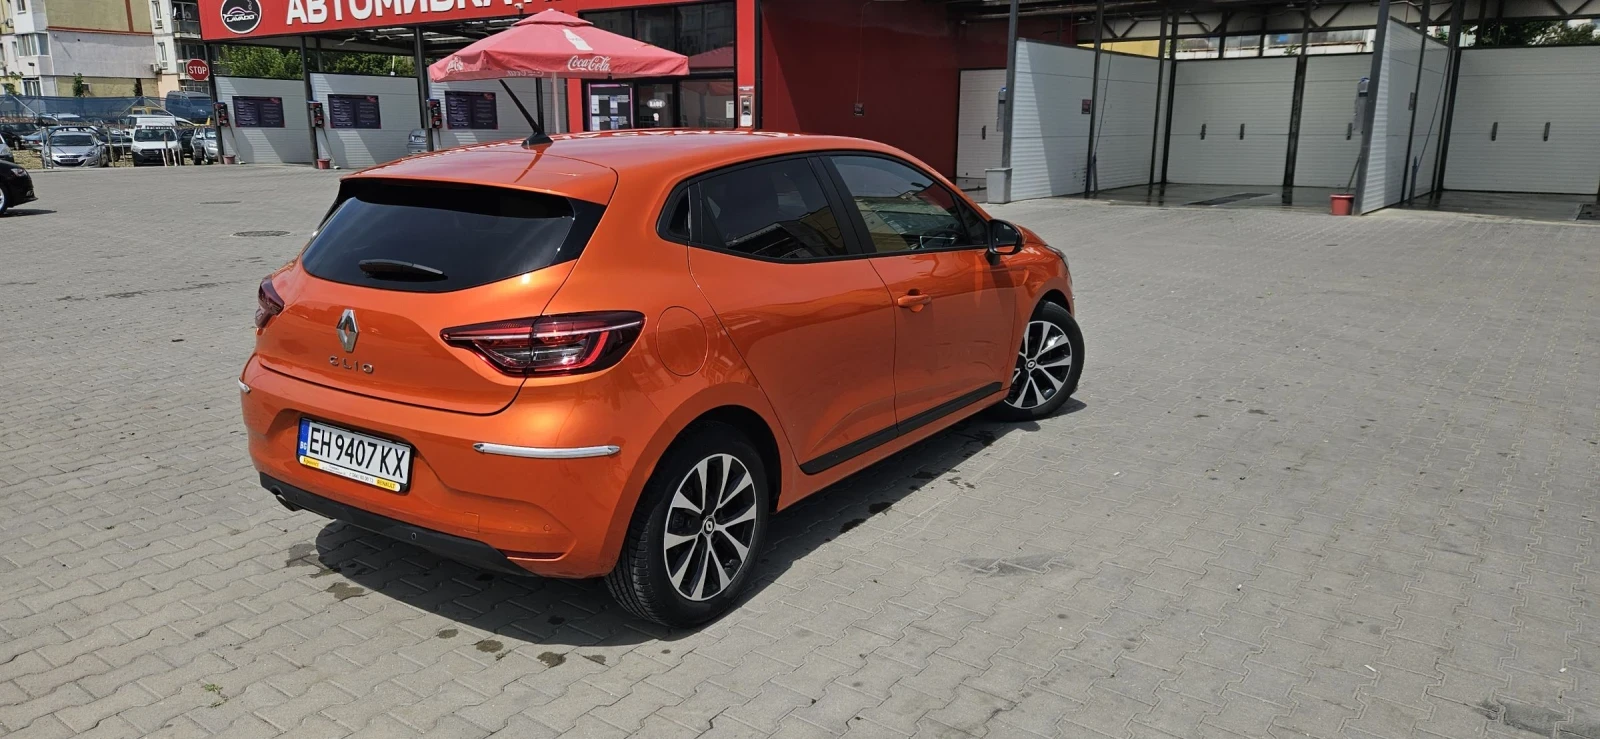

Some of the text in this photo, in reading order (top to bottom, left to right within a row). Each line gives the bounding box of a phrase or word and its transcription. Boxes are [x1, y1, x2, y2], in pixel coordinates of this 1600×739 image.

[567, 55, 611, 72] Coca-Cola
[188, 66, 207, 75] STOP
[329, 355, 374, 374] CLIO
[300, 441, 308, 450] BG
